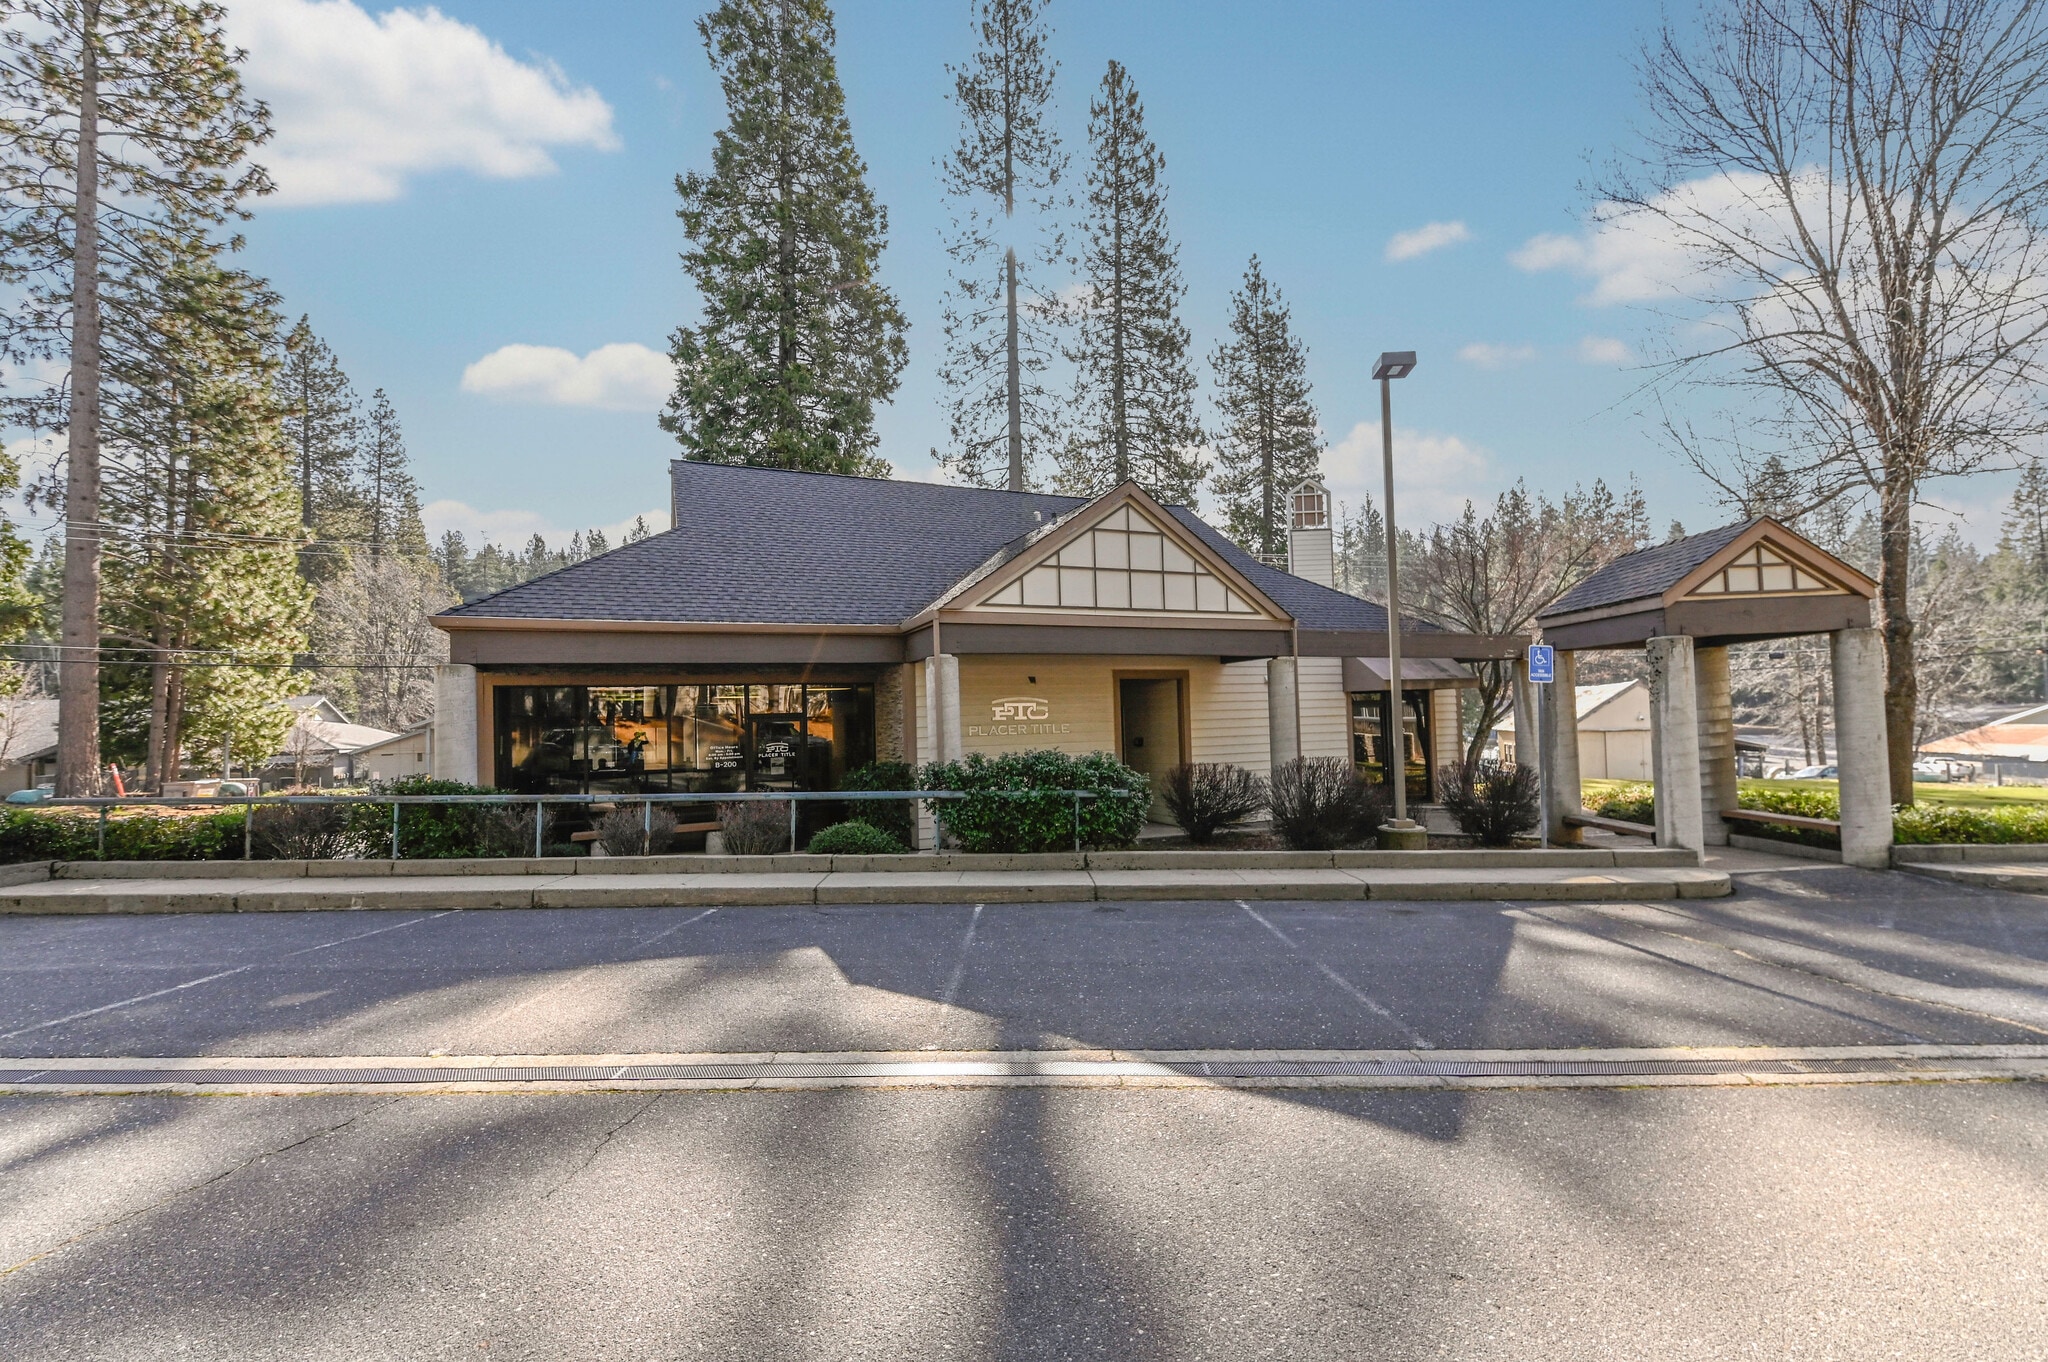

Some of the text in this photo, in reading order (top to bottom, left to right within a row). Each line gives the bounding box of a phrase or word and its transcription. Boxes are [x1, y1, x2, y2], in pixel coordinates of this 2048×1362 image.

[992, 702, 1048, 721] PTC
[969, 723, 1070, 736] PLACER TITLE
